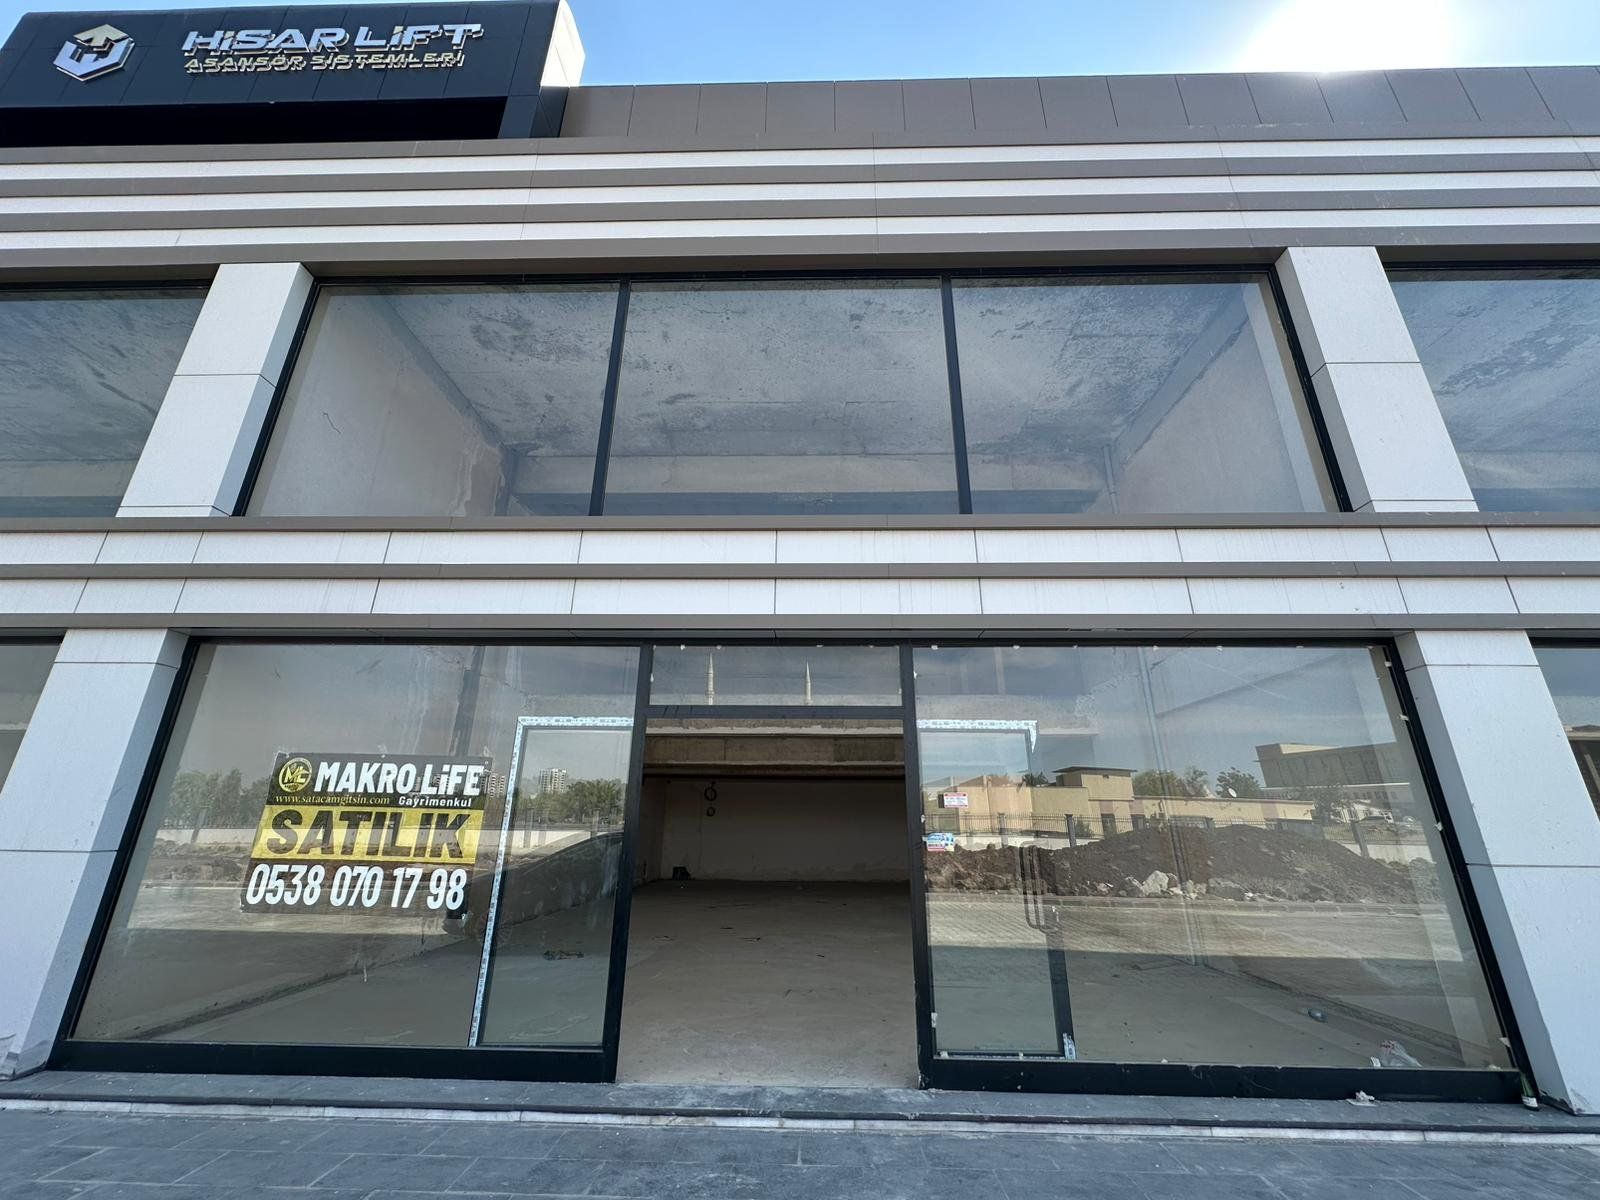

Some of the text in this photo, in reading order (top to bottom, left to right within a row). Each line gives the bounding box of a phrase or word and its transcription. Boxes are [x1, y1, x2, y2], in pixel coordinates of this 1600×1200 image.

[184, 54, 307, 73] ASANSÖR
[313, 761, 417, 794] MAKRO
[398, 796, 472, 808] Gayrimenkul
[266, 808, 471, 859] SATILIK
[245, 863, 468, 911] 0538 070 17 98
